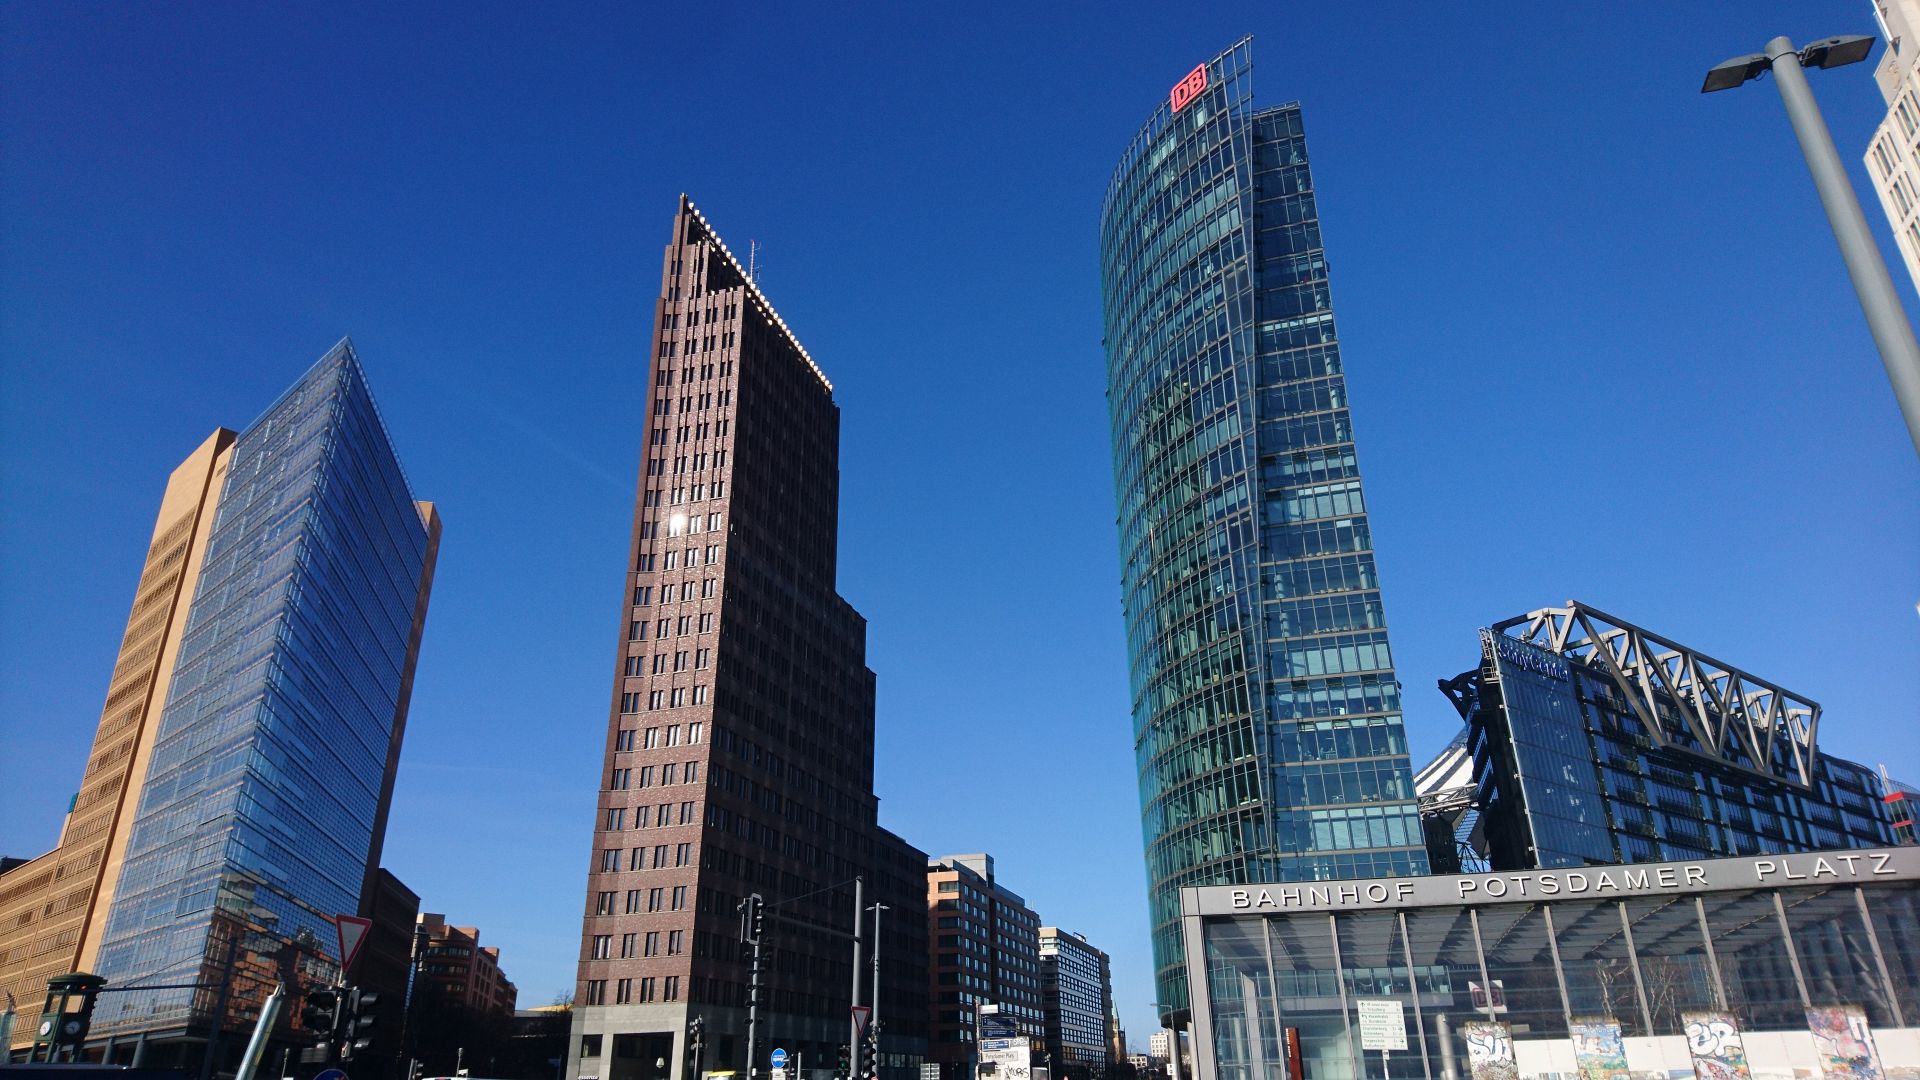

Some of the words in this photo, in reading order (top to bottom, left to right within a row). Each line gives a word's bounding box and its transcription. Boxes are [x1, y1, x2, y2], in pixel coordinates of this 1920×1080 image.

[1174, 71, 1204, 109] DB
[1231, 881, 1414, 908] BAHNHOF
[1457, 865, 1708, 899] POTSDAMER
[1754, 853, 1897, 881] PLATZ
